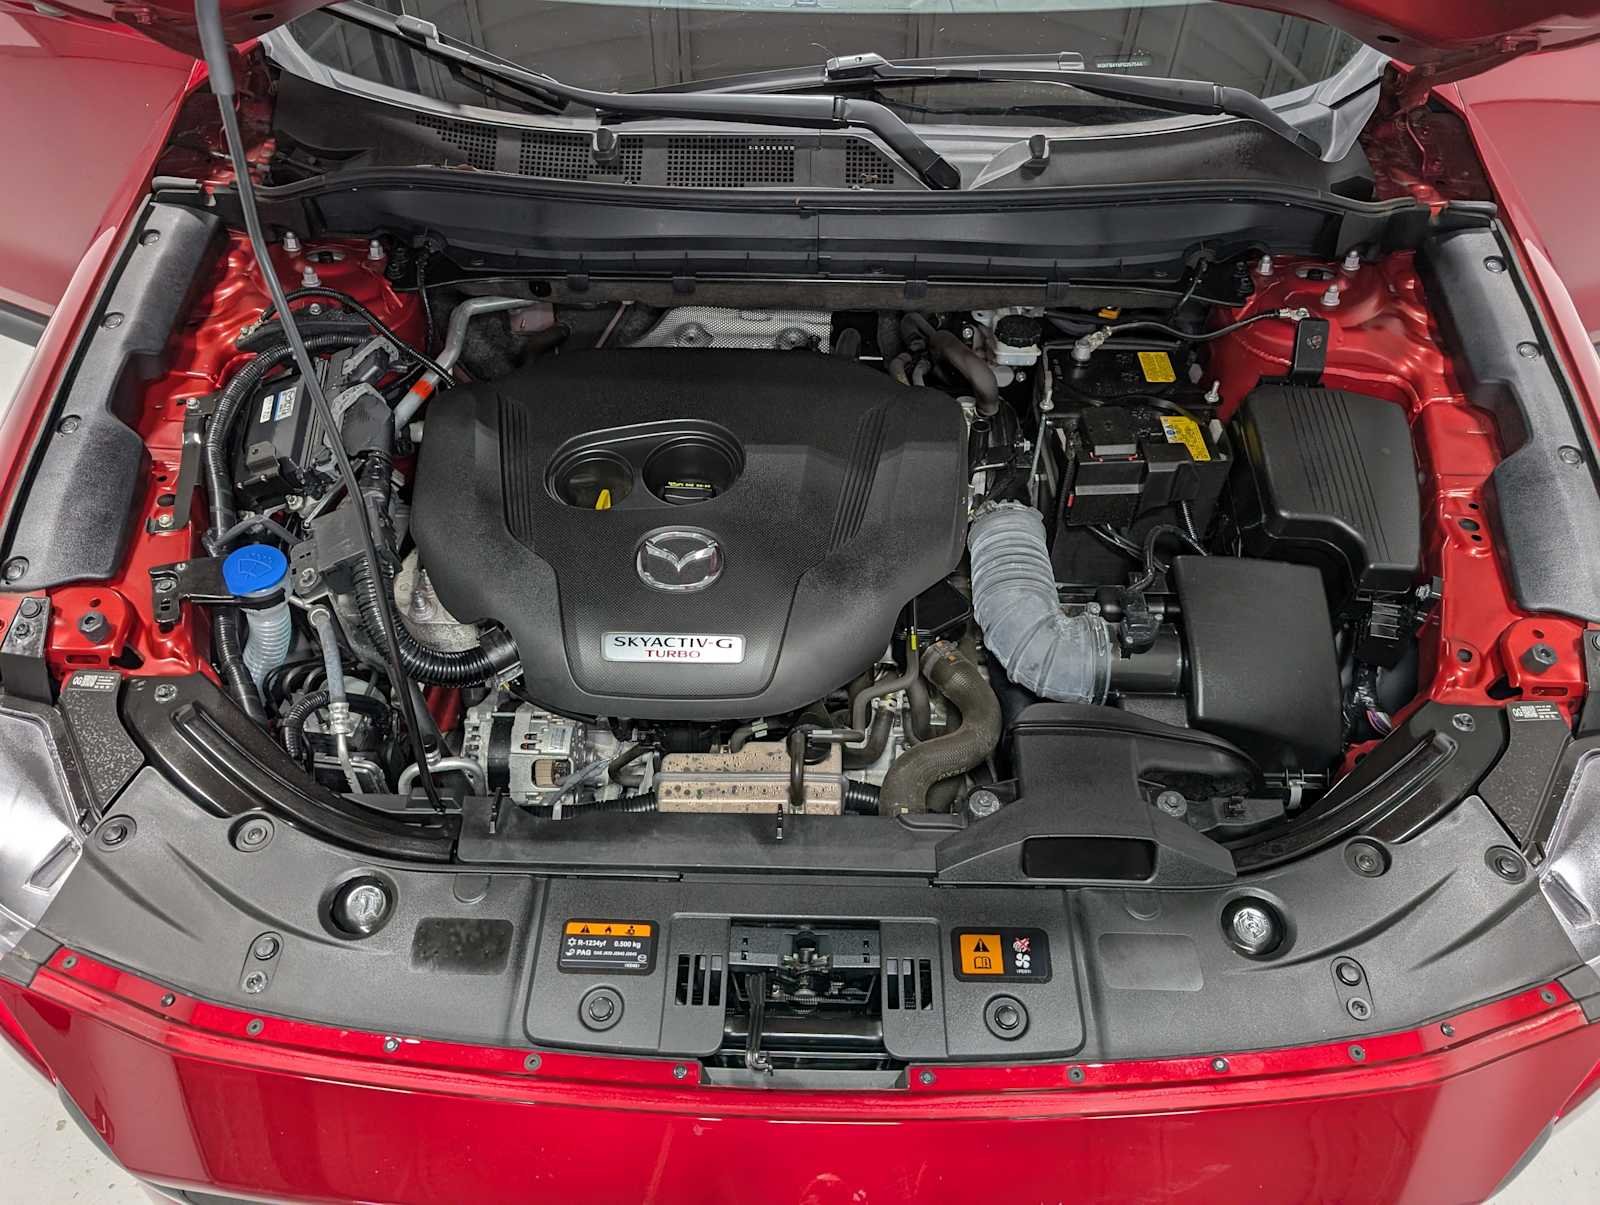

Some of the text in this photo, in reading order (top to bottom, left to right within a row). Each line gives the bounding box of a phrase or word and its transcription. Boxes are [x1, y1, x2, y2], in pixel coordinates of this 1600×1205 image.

[614, 636, 733, 649] SKYACTIV-G
[645, 649, 701, 658] TURBO
[577, 939, 607, 948] R-1234yf
[632, 940, 641, 949] kg
[576, 948, 592, 956] PAG
